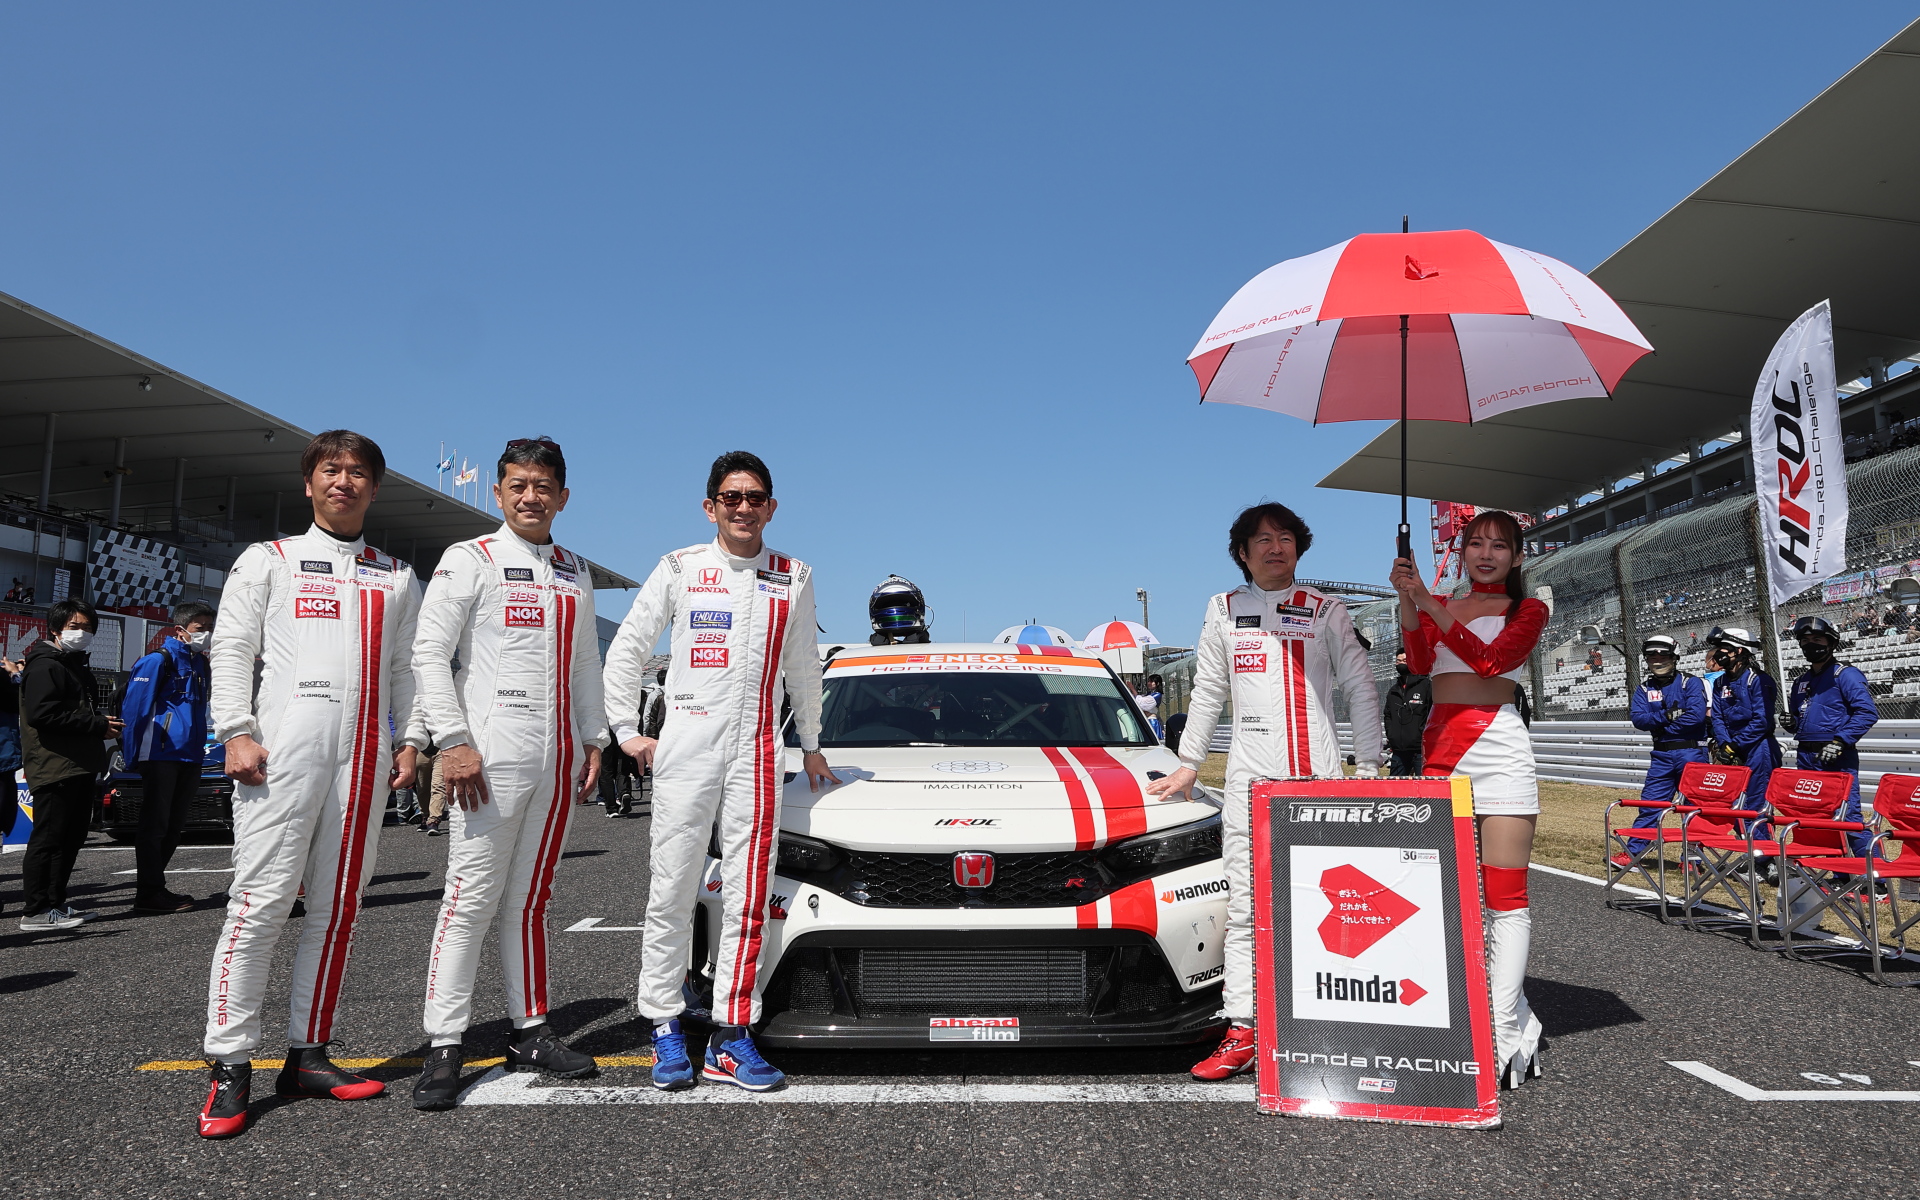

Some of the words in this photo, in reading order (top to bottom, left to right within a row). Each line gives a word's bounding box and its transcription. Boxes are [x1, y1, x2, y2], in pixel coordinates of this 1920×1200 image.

[1205, 322, 1256, 344] Honda
[1257, 304, 1313, 327] RACING
[1771, 370, 1811, 575] HRDC
[667, 553, 682, 574] sparco
[293, 573, 345, 585] Honda
[349, 578, 394, 591] RACING
[298, 582, 338, 596] BBS
[500, 582, 543, 590] Honda
[548, 584, 581, 596] RACING
[687, 586, 731, 595] HONDA
[507, 591, 539, 604] BBS
[299, 599, 337, 612] NGK
[508, 607, 542, 621] NGK
[692, 611, 730, 622] ENDLESS
[694, 632, 727, 644] BBS
[1003, 635, 1012, 644] 6
[1057, 635, 1066, 644] 6
[1270, 630, 1315, 639] RACING
[1234, 640, 1263, 651] BBS
[693, 648, 726, 661] NGK
[928, 654, 1018, 663] ENEOS
[1235, 655, 1264, 667] NGK
[871, 664, 961, 673] Honda
[967, 665, 1063, 673] RACING
[1702, 772, 1727, 787] BBS
[1794, 778, 1823, 796] BBS
[934, 818, 1002, 827] HRDC
[1174, 879, 1231, 902] Hankoo
[426, 930, 446, 1001] RACING
[217, 951, 234, 1027] RACING
[1315, 971, 1398, 1004] Honda
[930, 1018, 1019, 1027] ahead
[971, 1026, 1015, 1041] film
[1272, 1049, 1368, 1069] Honda
[1375, 1055, 1481, 1076] RACING
